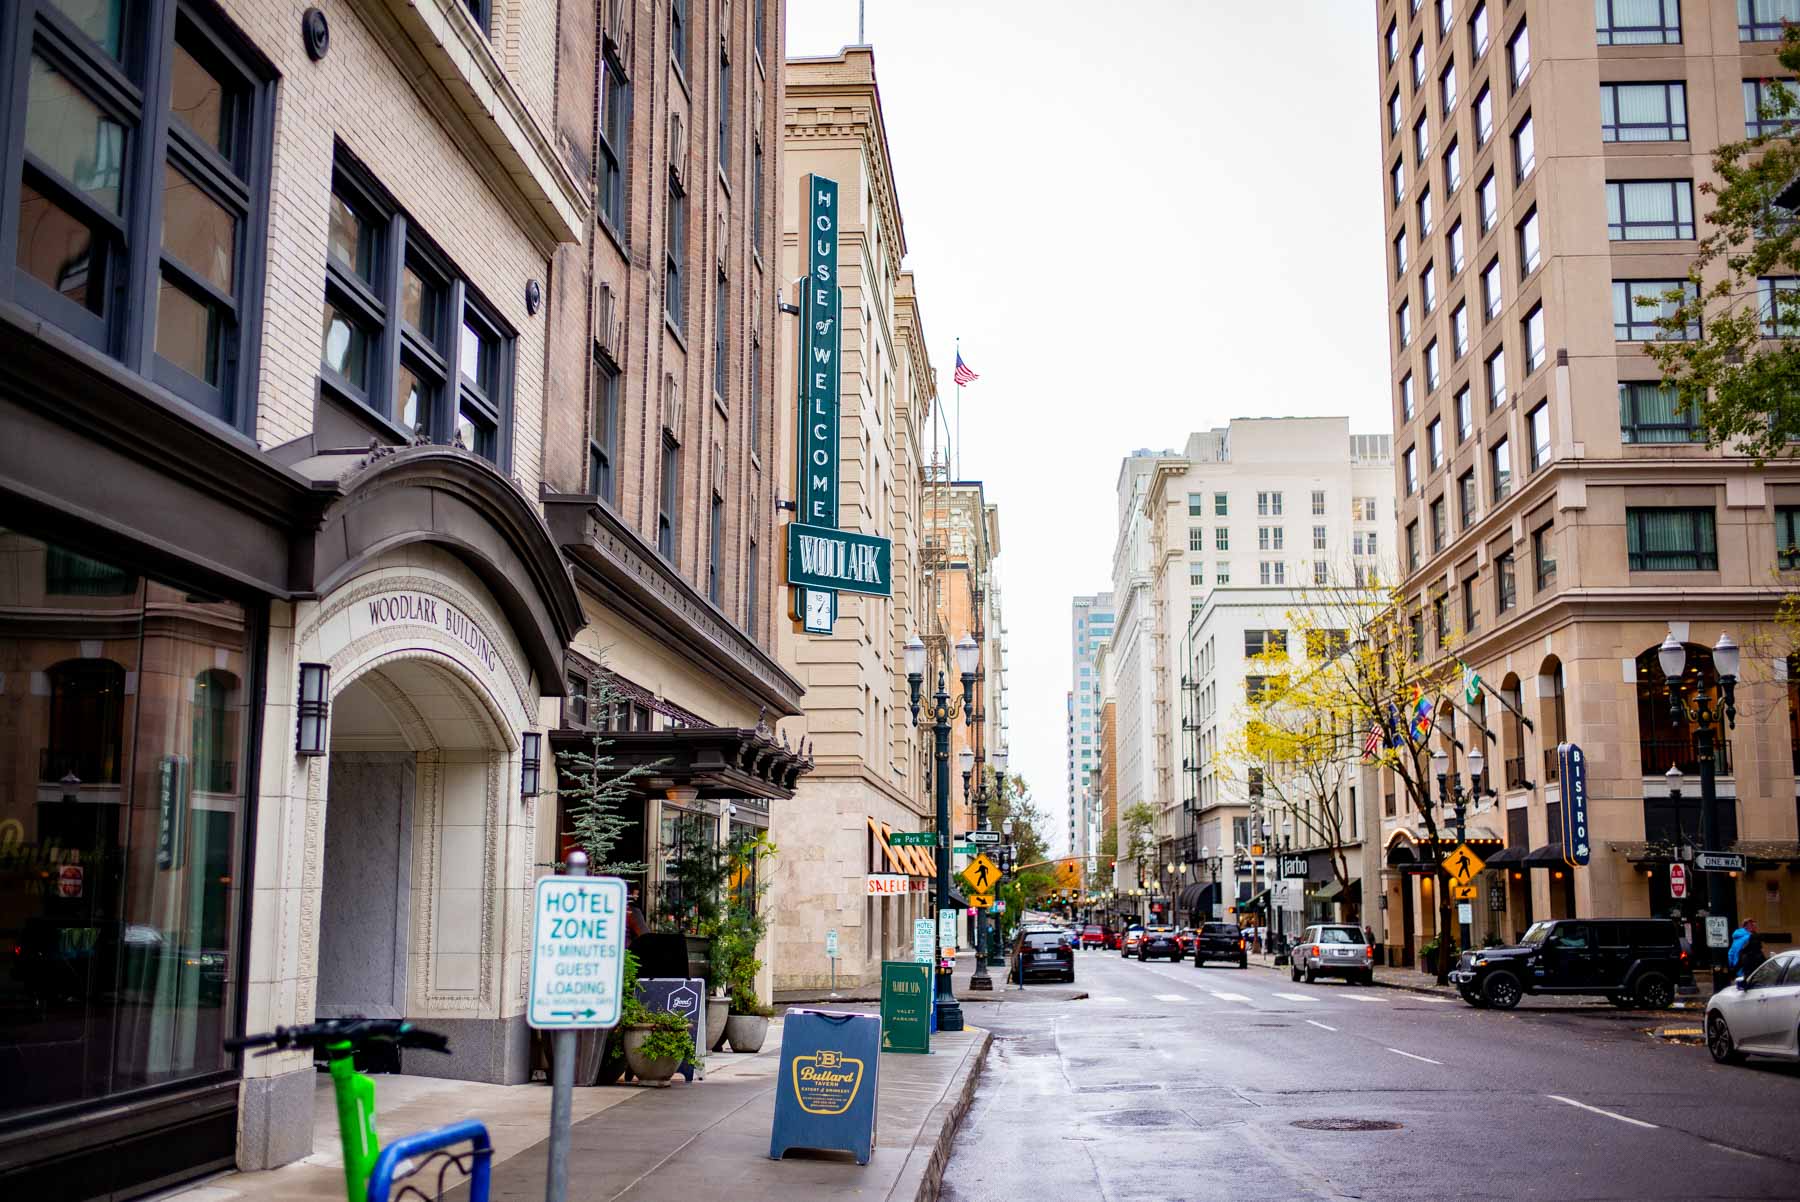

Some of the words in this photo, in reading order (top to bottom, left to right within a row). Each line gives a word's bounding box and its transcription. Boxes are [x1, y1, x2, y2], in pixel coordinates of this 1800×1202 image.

[816, 190, 832, 306] HOUSE
[815, 318, 834, 335] of
[813, 347, 831, 518] WELCOME
[368, 595, 438, 625] WOODLARK
[445, 608, 496, 672] BUILDING
[1573, 751, 1585, 838] BISTRO
[905, 835, 920, 843] Park
[1284, 856, 1308, 876] jarbo
[1705, 857, 1720, 866] ONE
[1723, 858, 1739, 866] WAY
[546, 891, 615, 914] HOTEL
[551, 918, 608, 939] ZONE
[540, 944, 553, 957] 15
[559, 944, 616, 958] MINUTES
[555, 963, 599, 976] GUEST
[546, 981, 605, 995] LOADING
[822, 1053, 835, 1066] B
[801, 1066, 854, 1082] Bullard
